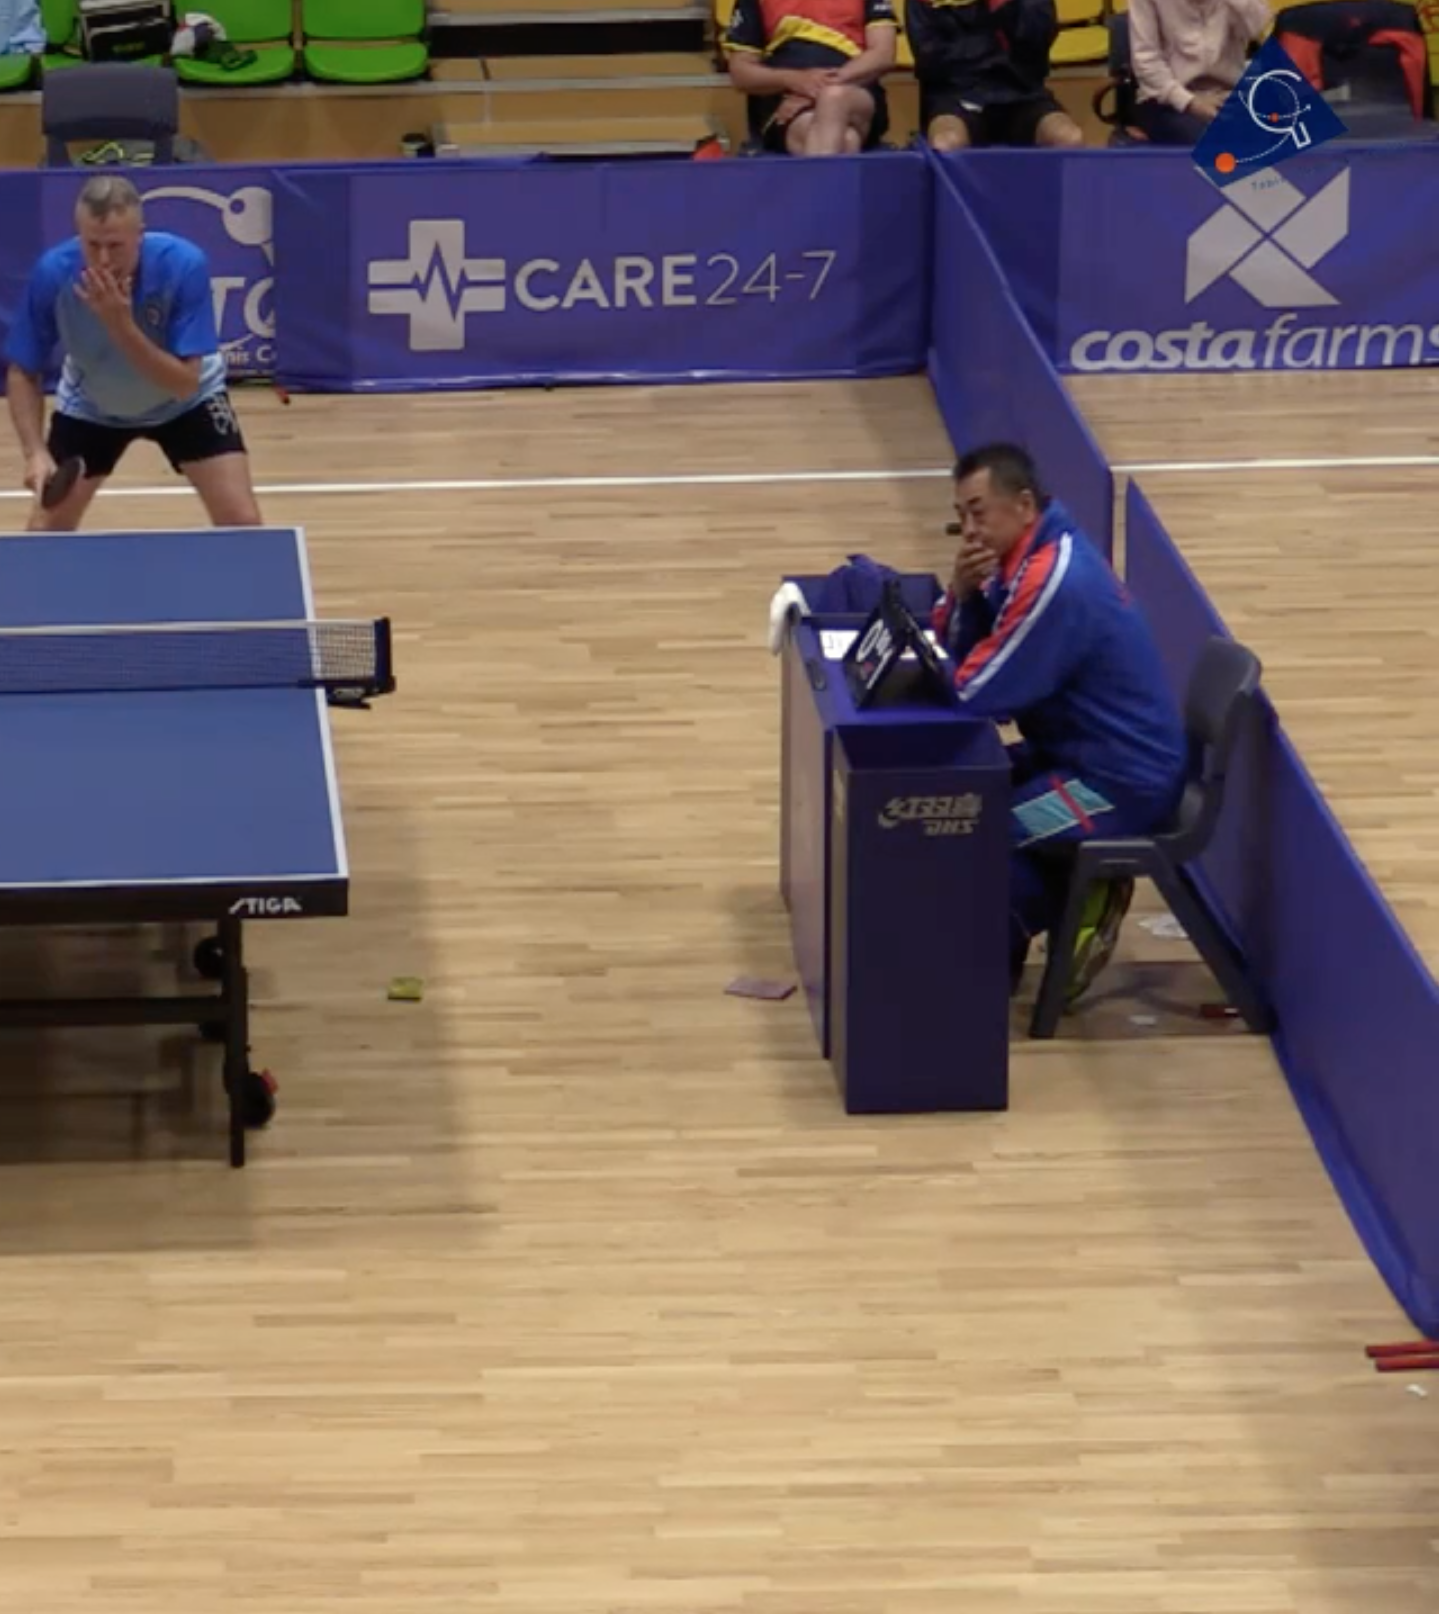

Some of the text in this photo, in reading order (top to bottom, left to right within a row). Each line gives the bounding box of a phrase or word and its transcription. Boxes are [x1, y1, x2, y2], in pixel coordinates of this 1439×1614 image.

[514, 250, 837, 311] CARE 24-7
[1069, 321, 1257, 371] costa
[227, 897, 303, 915] STIGA
